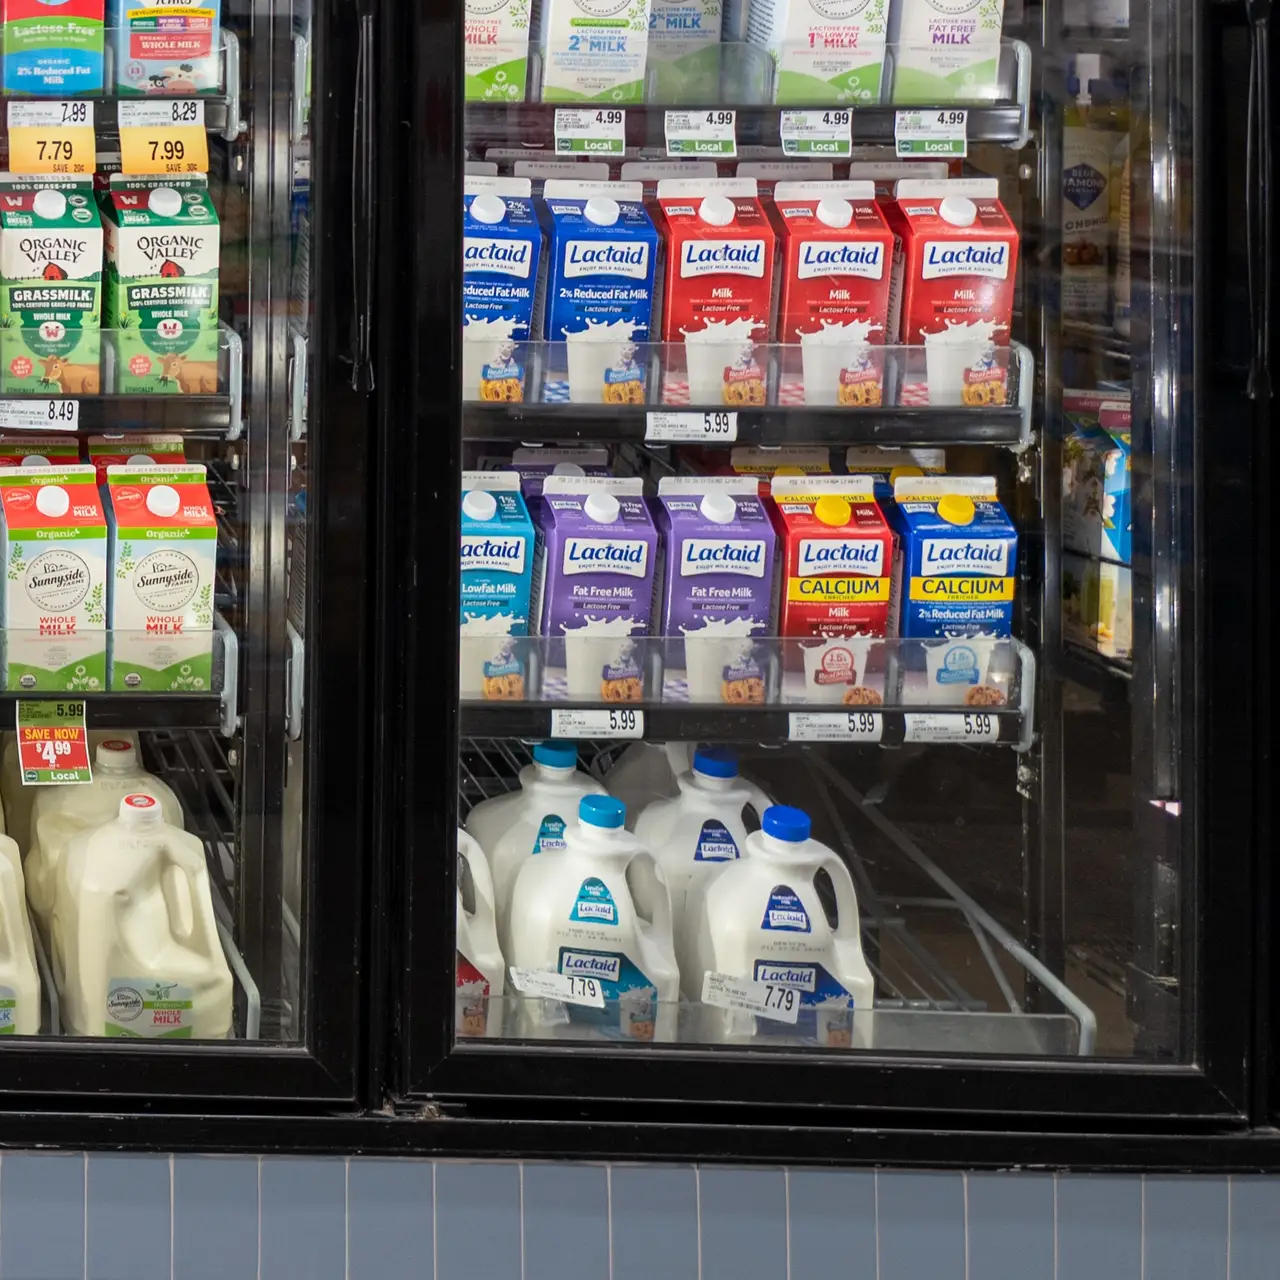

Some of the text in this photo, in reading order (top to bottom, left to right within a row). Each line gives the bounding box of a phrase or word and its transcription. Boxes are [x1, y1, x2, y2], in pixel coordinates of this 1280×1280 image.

[172, 41, 200, 49] MILK
[932, 34, 971, 44] MILK
[706, 112, 732, 124] 4.99
[937, 112, 964, 124] 4.99
[149, 140, 184, 160] 7.99
[695, 142, 722, 151] Local
[570, 245, 644, 264] Lactaid
[560, 288, 648, 299] 2% Reduced Fat Milk
[712, 288, 732, 298] Milk
[704, 413, 729, 433] 5.99
[36, 530, 75, 540] Organic
[569, 542, 642, 563] Lactaid
[574, 586, 633, 596] Fat Free Milk
[800, 580, 880, 594] CALCIUM
[57, 704, 83, 717] 5.99
[964, 714, 991, 734] 5.99
[565, 955, 617, 974] Lactaid
[567, 977, 597, 997] 7.79
[764, 985, 794, 1011] 7.79
[153, 1015, 181, 1024] MILK
